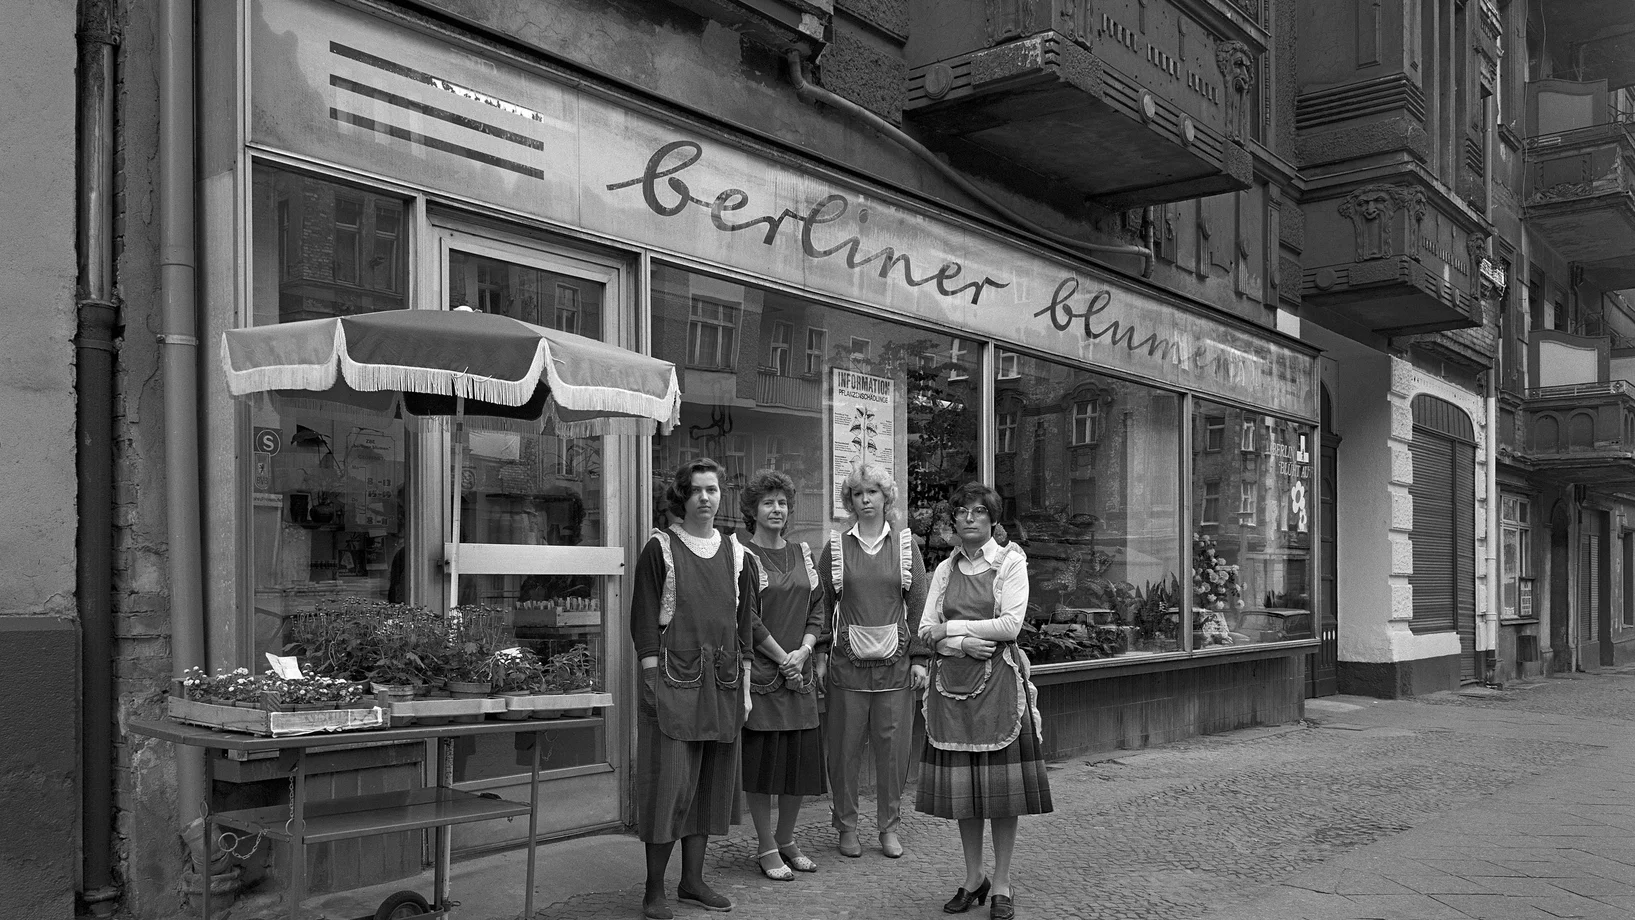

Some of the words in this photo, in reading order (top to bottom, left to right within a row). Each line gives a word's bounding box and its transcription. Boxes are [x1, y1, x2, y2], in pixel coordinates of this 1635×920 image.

[606, 139, 1011, 306] berliner
[1033, 276, 1244, 386] blumen
[838, 371, 890, 396] INFORMATION
[262, 435, 275, 451] S
